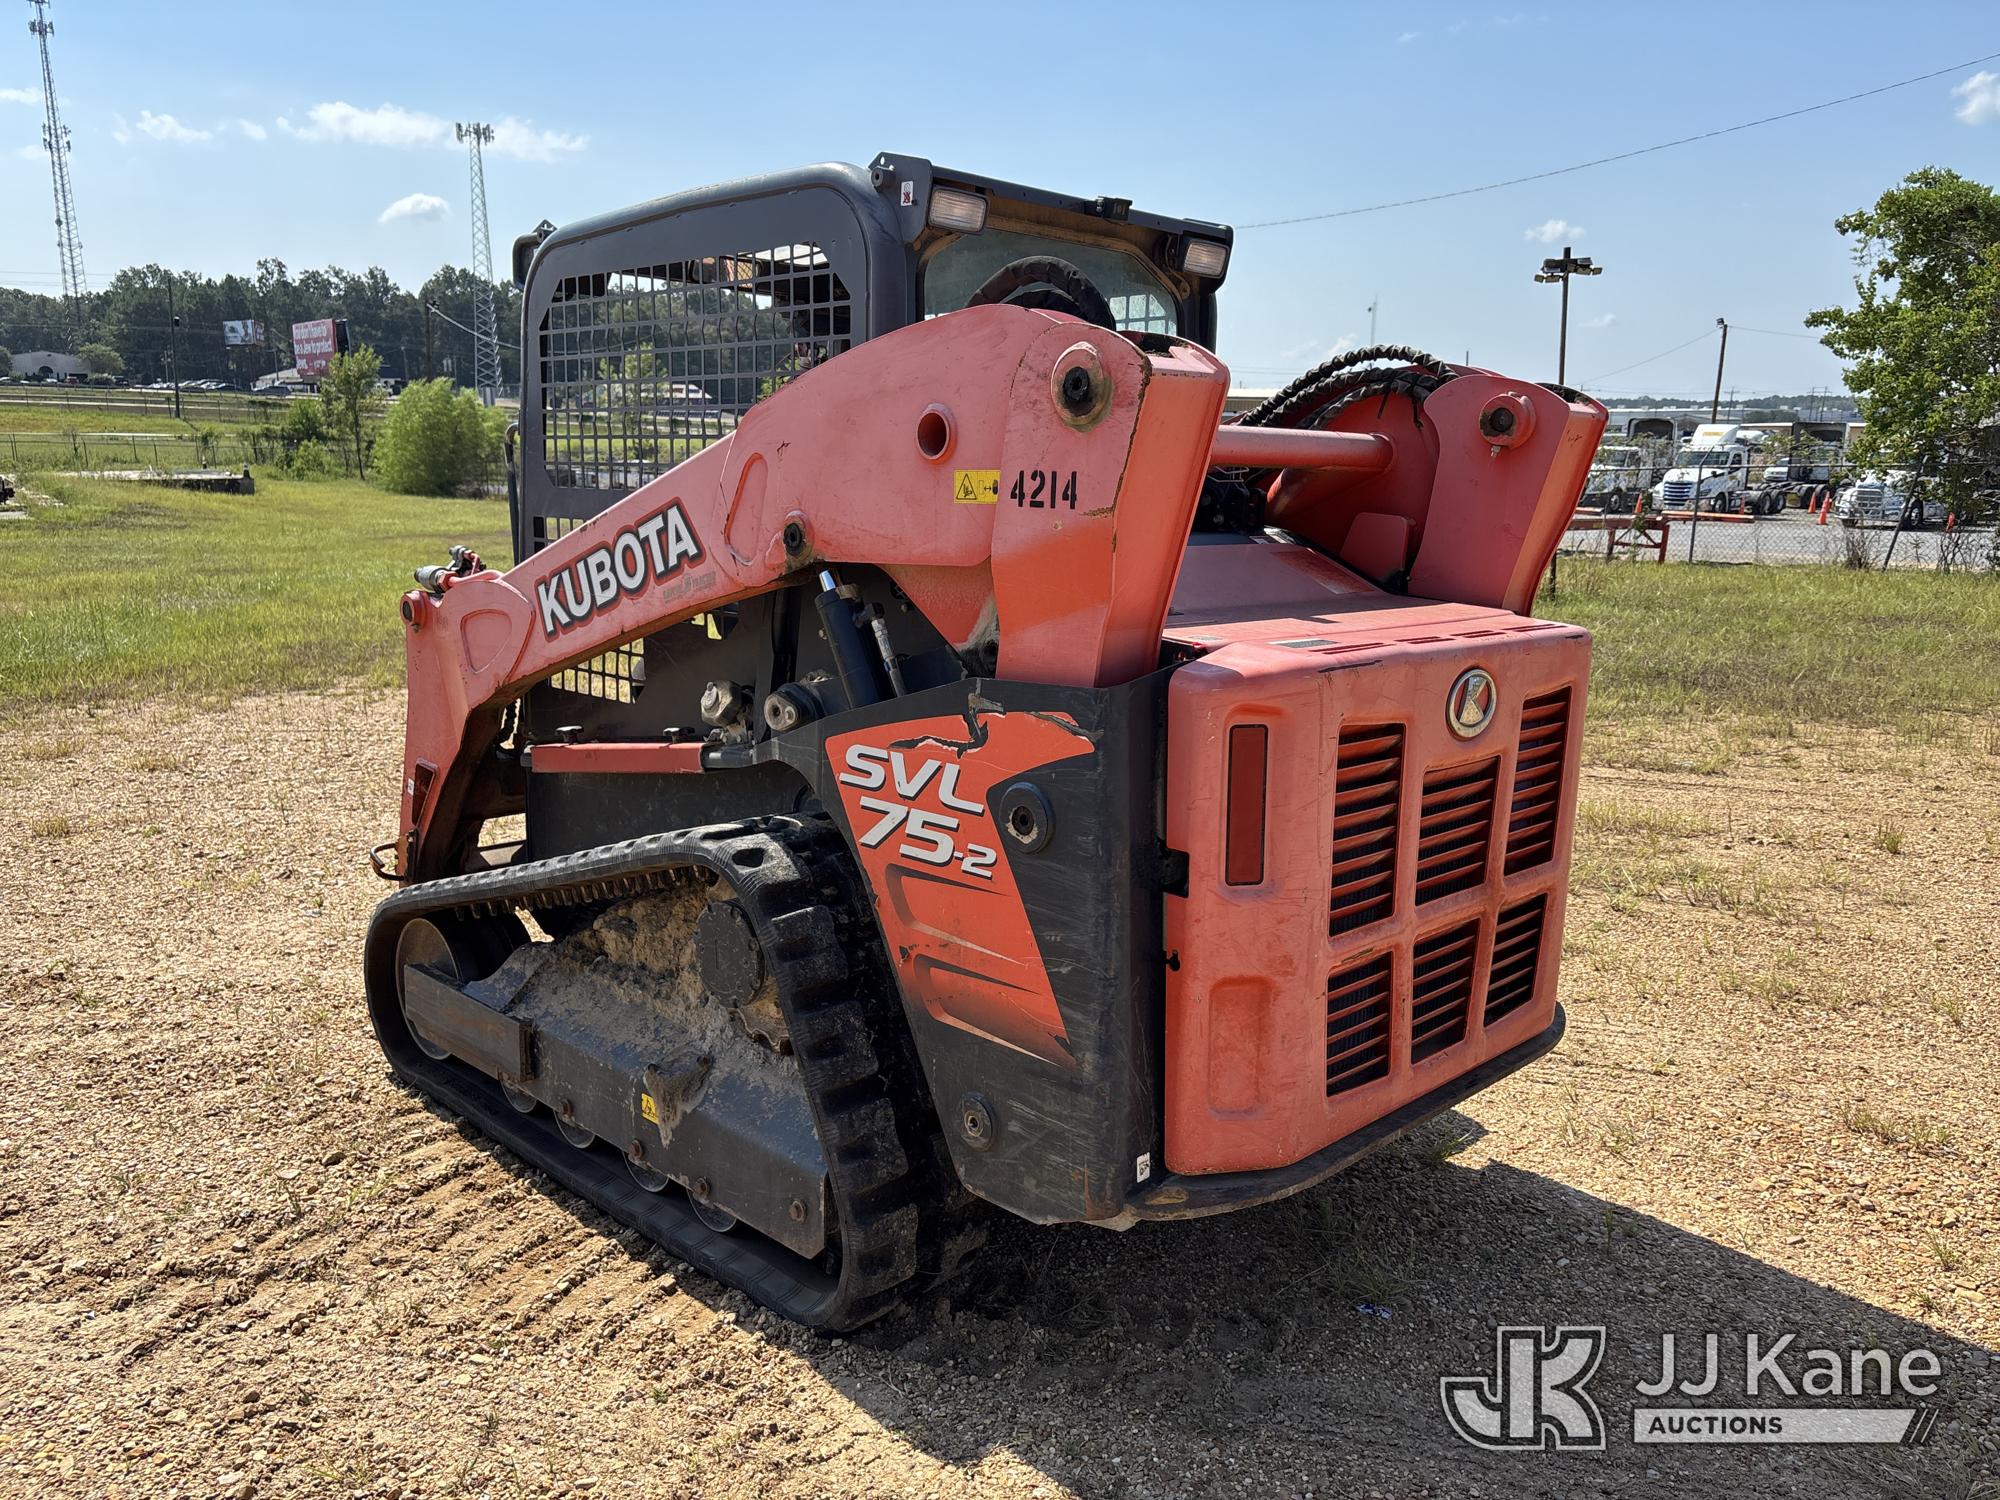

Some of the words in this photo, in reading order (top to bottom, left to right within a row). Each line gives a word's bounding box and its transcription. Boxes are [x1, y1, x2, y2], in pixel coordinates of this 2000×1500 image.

[1010, 470, 1078, 510] 4214
[537, 505, 699, 634] KUBOTA
[839, 744, 985, 815] SVL
[858, 796, 998, 880] 75-2
